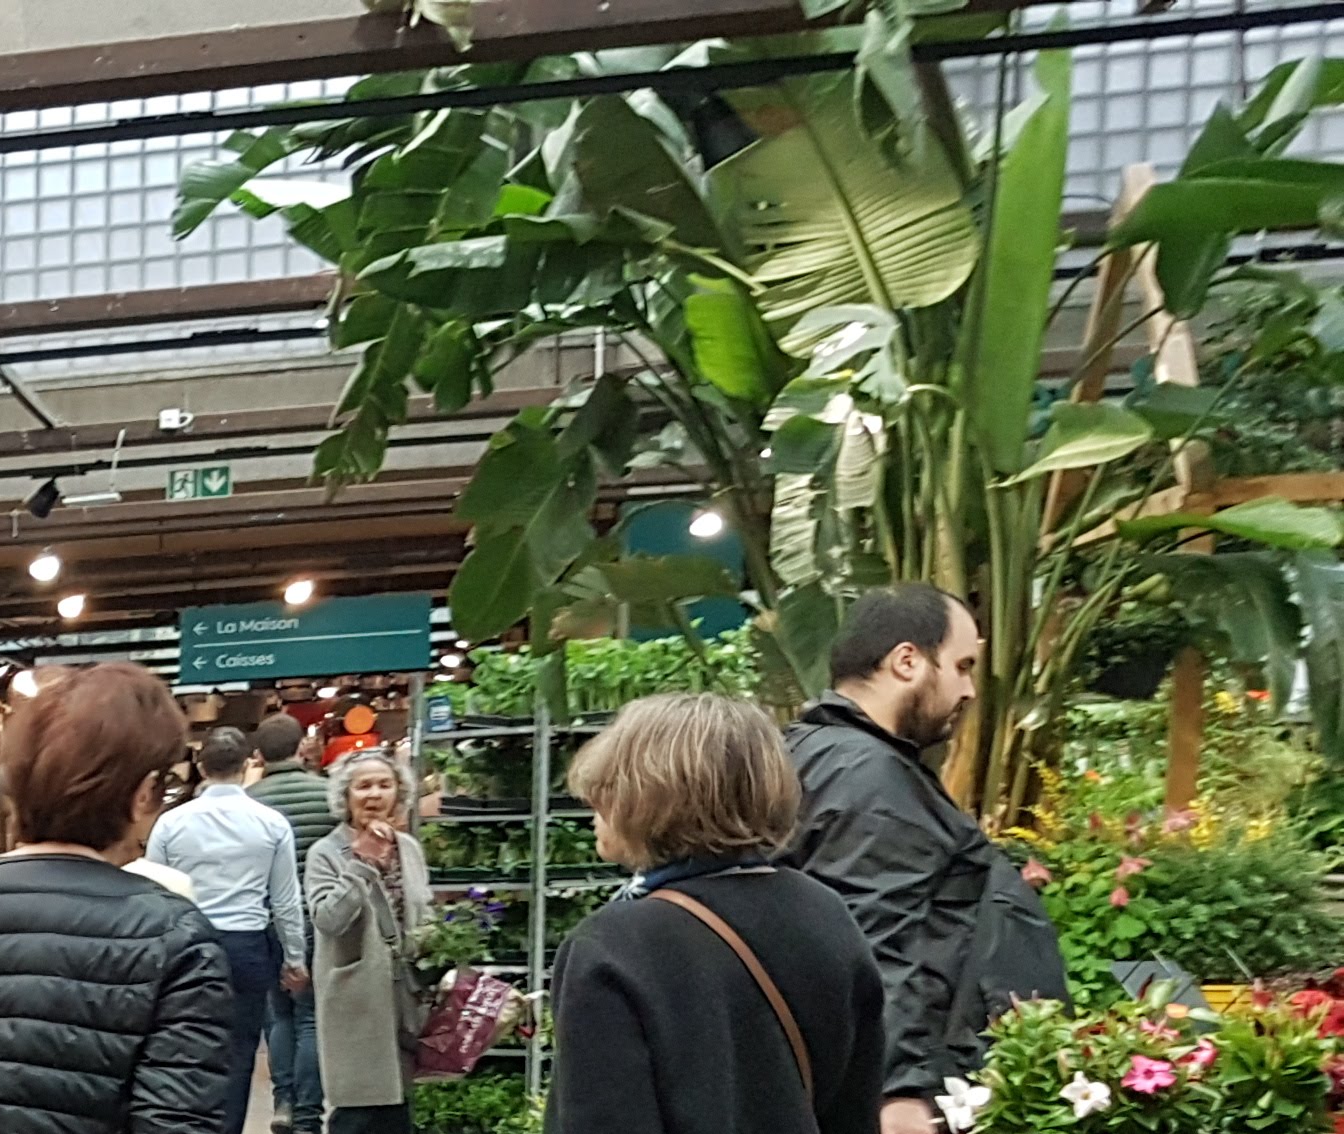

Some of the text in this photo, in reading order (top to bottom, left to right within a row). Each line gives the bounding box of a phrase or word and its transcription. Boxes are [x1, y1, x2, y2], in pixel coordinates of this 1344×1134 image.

[216, 617, 300, 634] La Maison
[215, 653, 276, 668] Caisses
